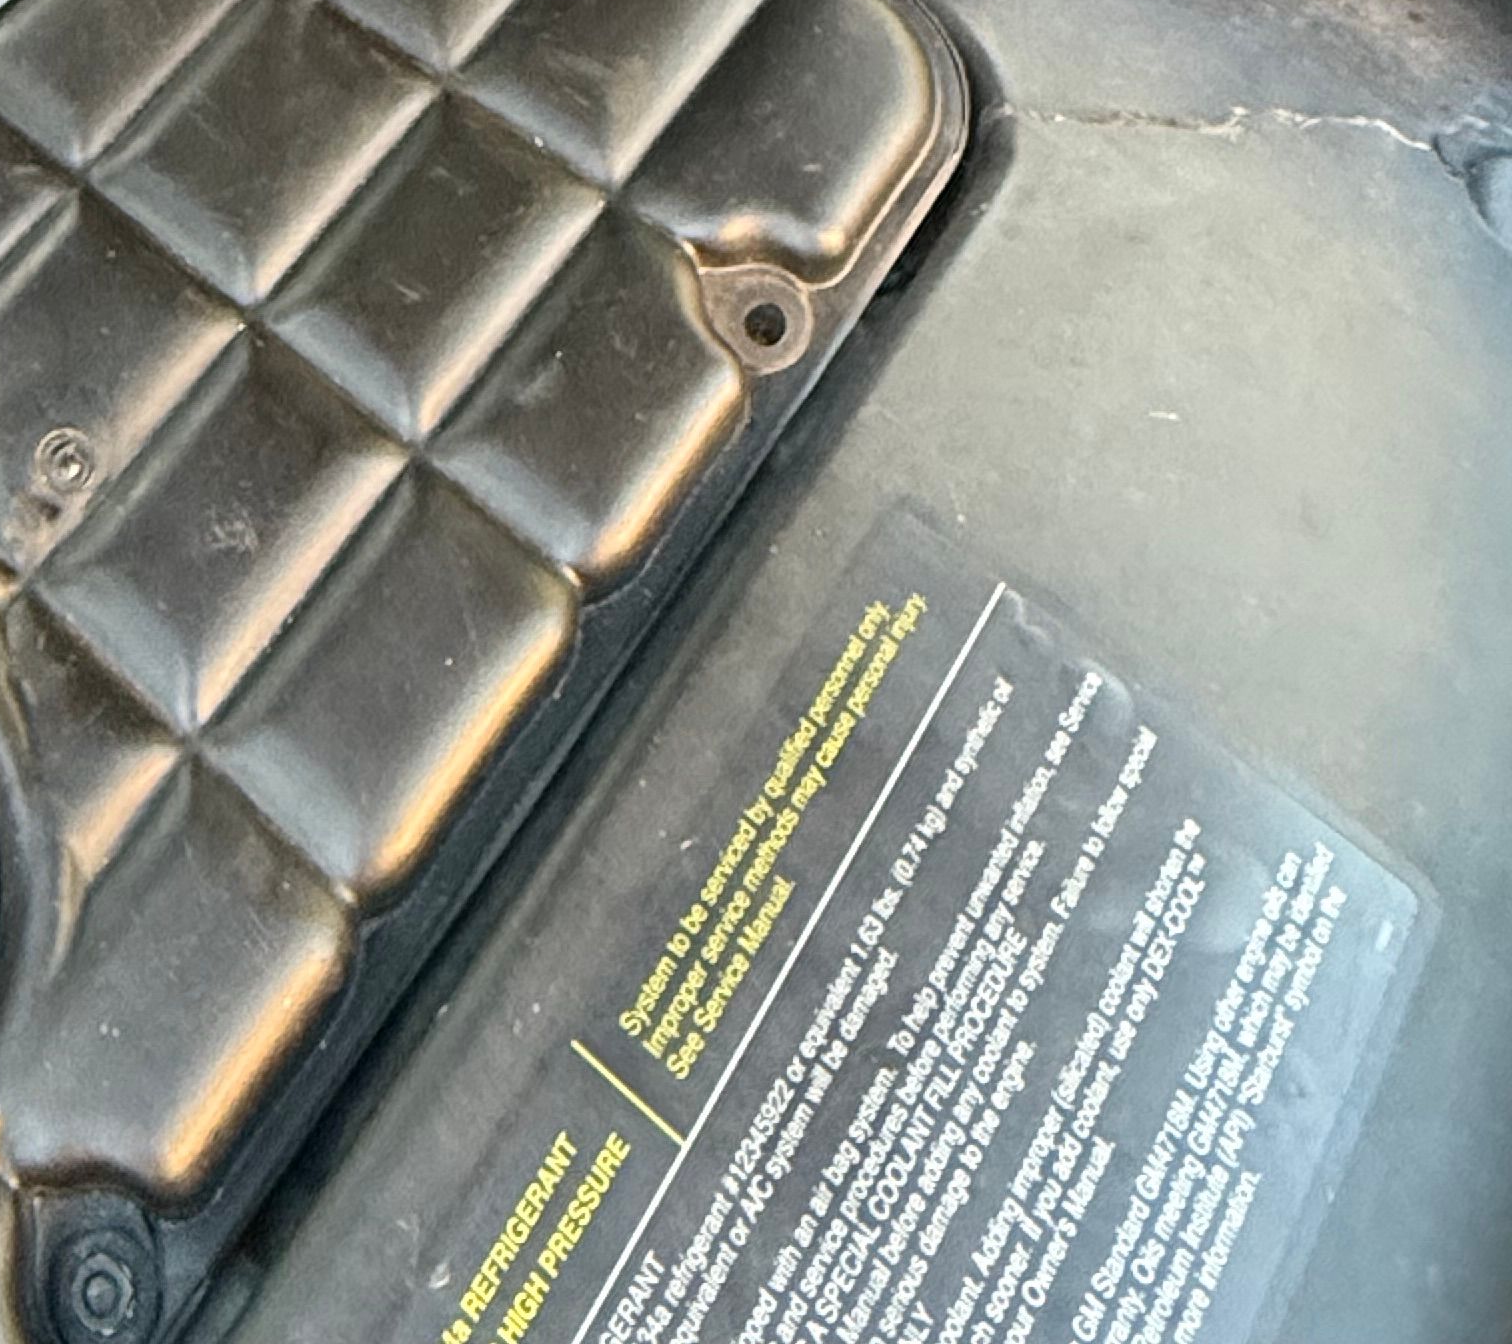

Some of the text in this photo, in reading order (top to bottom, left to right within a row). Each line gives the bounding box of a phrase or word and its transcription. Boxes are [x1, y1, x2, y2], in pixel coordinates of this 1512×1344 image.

[808, 634, 867, 728] personnel
[1058, 671, 1104, 734] Service
[763, 716, 818, 800] qualified
[1044, 730, 1072, 766] see
[1118, 725, 1158, 790] special
[743, 794, 776, 826] by
[1090, 784, 1129, 839] follow
[641, 959, 708, 1059] Improper
[700, 890, 752, 966] service
[742, 806, 800, 894] methods
[790, 764, 828, 812] may
[814, 711, 856, 769] cause
[845, 634, 899, 718] personal
[700, 818, 758, 908] serviced
[964, 827, 1020, 920] unwanted
[1081, 836, 1106, 858] to
[1050, 855, 1096, 920] Failure
[1284, 840, 1336, 926] identified
[1319, 885, 1348, 920] the
[666, 932, 691, 958] to
[678, 903, 709, 935] be
[1275, 922, 1302, 953] be
[1310, 916, 1334, 945] on
[666, 874, 796, 1080] See Service Manual.
[928, 912, 976, 999] prevent
[1018, 921, 1065, 992] system.
[1260, 946, 1294, 994] may
[1283, 937, 1324, 1012] symbol
[618, 955, 678, 1037] System
[663, 1192, 734, 1308] refrigerant
[721, 1077, 796, 1197] #12345922
[786, 1054, 807, 1084] or
[798, 956, 862, 1060] equivalent
[850, 914, 884, 960] 1.63
[871, 887, 904, 921] lbs.
[890, 832, 929, 887] (0.74
[914, 804, 948, 840] kg)
[935, 768, 964, 810] and
[954, 700, 1003, 776] synthetic
[992, 675, 1014, 704] oil
[838, 946, 899, 1042] damaged.
[900, 986, 939, 1034] help
[946, 919, 1028, 1066] PROCEDURE
[1004, 988, 1029, 1014] to
[1236, 989, 1283, 1049] which
[820, 1039, 849, 1071] be
[886, 1029, 916, 1057] To
[970, 1196, 1027, 1278] Adding
[1006, 1104, 1065, 1202] improper
[1050, 1012, 1114, 1112] (silicated)
[1098, 943, 1149, 1017] coolant
[1129, 910, 1159, 957] will
[1144, 847, 1188, 925] shorten
[1173, 818, 1202, 851] the
[972, 1007, 1019, 1084] coolant
[990, 1040, 1037, 1111] engine.
[775, 840, 1046, 1344] and service procedures before performing any service.
[804, 1062, 834, 1104] will
[847, 1067, 899, 1144] system.
[922, 1063, 964, 1112] FILL
[952, 1080, 986, 1126] any
[1018, 1211, 1044, 1242] If
[1031, 1175, 1064, 1231] you
[1052, 1131, 1083, 1182] add
[1070, 1060, 1122, 1140] coolant,
[1107, 1019, 1138, 1061] use
[1125, 976, 1159, 1023] only
[1071, 1292, 1107, 1342] GM
[1090, 1194, 1151, 1300] Standard
[1183, 1028, 1230, 1090] Using
[1213, 978, 1247, 1033] other
[1234, 918, 1273, 984] engine
[1261, 885, 1289, 922] oils
[1276, 852, 1303, 890] can
[764, 1102, 815, 1180] system
[917, 1120, 968, 1196] adding
[957, 1134, 984, 1171] to
[969, 1097, 1001, 1148] the
[1208, 1108, 1257, 1169] (API)
[820, 1139, 861, 1187] bag
[866, 1103, 936, 1221] COOLANT
[1153, 1153, 1208, 1242] meeting
[459, 1130, 578, 1324] REFRIGERANT
[728, 1216, 751, 1247] or
[739, 1174, 774, 1224] A/C
[792, 1213, 819, 1248] an
[808, 1181, 834, 1218] air
[877, 1192, 927, 1266] before
[917, 1168, 972, 1257] damage
[1020, 1216, 1078, 1308] Owner's
[1060, 1134, 1116, 1221] Manual.
[1177, 1163, 1230, 1250] Institute
[496, 1131, 631, 1344] HIGH PRESSURE
[767, 1244, 803, 1293] with
[814, 1218, 882, 1325] SPECIAL
[1129, 1238, 1166, 1286] Oils
[1172, 1161, 1263, 1344] more information.
[804, 1320, 830, 1344] A
[834, 1257, 892, 1344] Manual
[878, 1254, 929, 1339] serious
